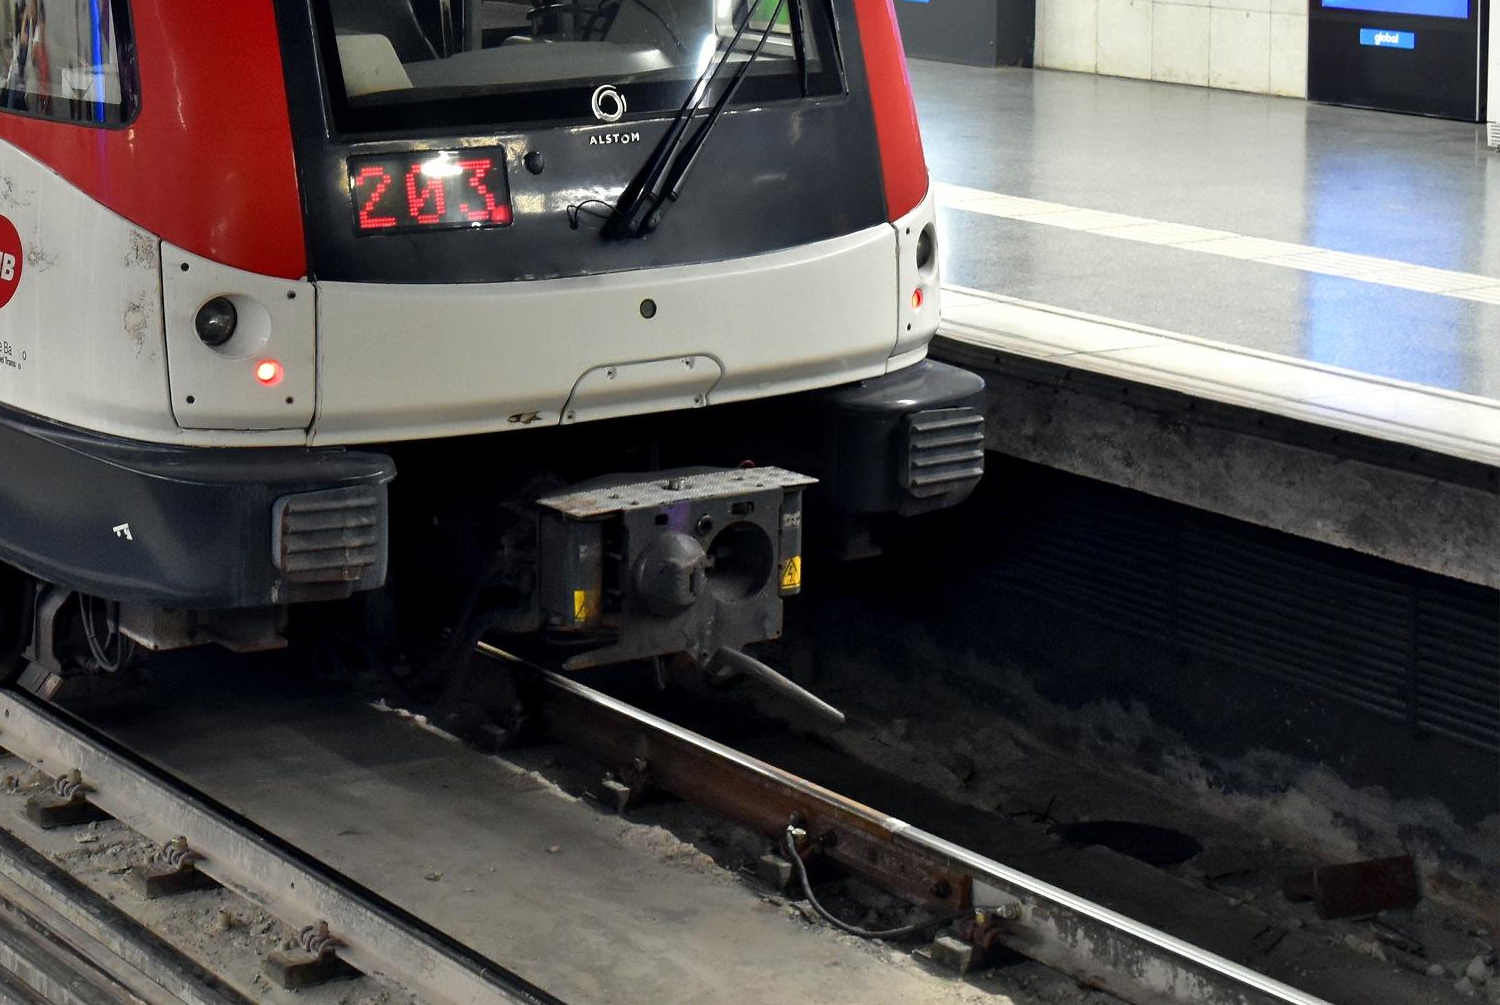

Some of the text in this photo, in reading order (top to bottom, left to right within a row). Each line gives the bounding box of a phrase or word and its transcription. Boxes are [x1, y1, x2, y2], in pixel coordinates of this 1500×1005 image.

[1374, 32, 1399, 46] global
[589, 132, 640, 145] ALSTOM
[356, 159, 496, 229] 203
